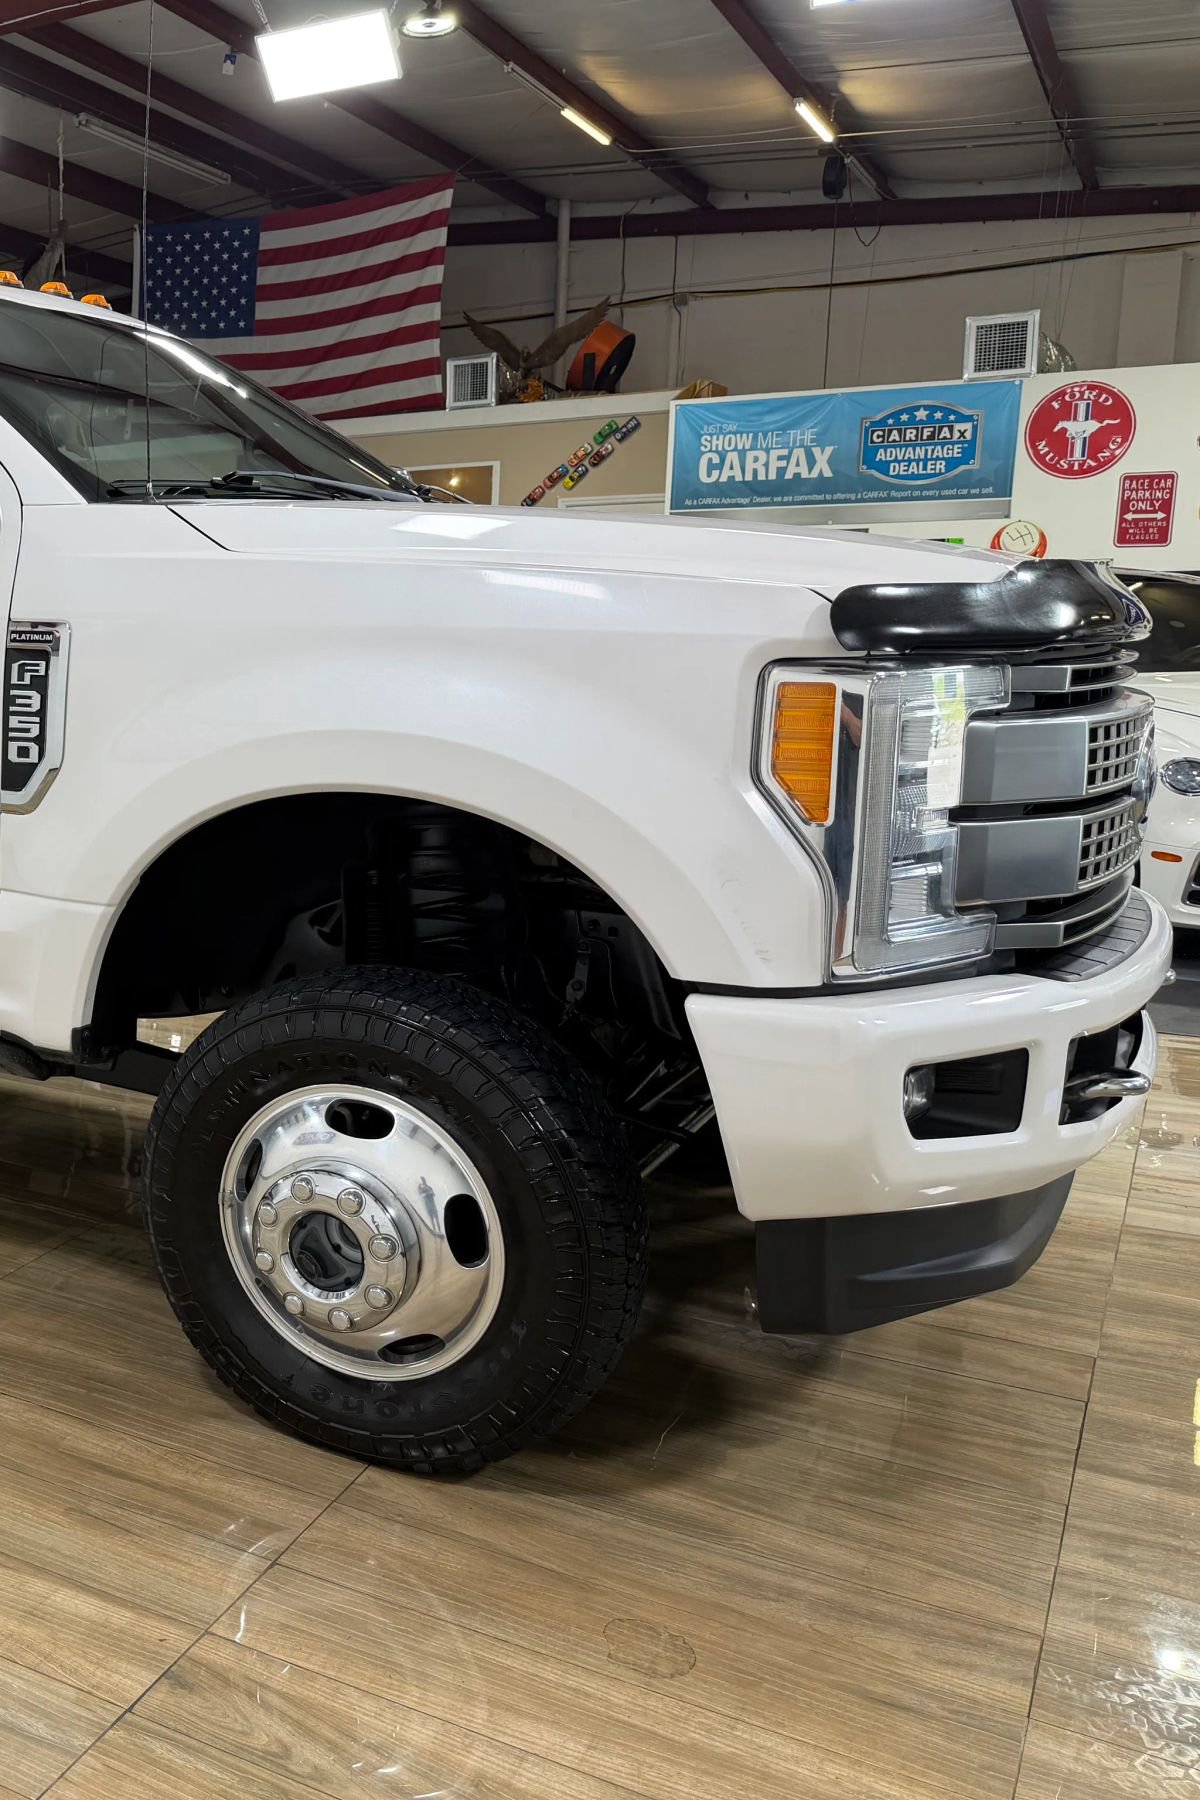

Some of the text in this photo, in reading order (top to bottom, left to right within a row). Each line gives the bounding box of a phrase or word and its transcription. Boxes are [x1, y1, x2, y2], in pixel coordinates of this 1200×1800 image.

[1051, 389, 1113, 410] FORD
[701, 424, 738, 434] JUST SAY
[872, 426, 968, 443] CARFAX
[700, 428, 818, 452] SHOW ME THE
[875, 443, 963, 461] ADVANTAGE
[1036, 435, 1122, 471] MUSTANG
[699, 445, 834, 484] CARFAX
[889, 459, 946, 476] DEALER
[1124, 478, 1173, 490] RACE CAR
[793, 493, 824, 502] committed
[832, 491, 856, 500] offering
[890, 490, 911, 499] Report
[940, 488, 956, 496] used
[1124, 488, 1171, 501] PARKING
[1129, 500, 1162, 511] ONLY
[10, 632, 53, 641] PLATINUM
[7, 660, 46, 764] F350
